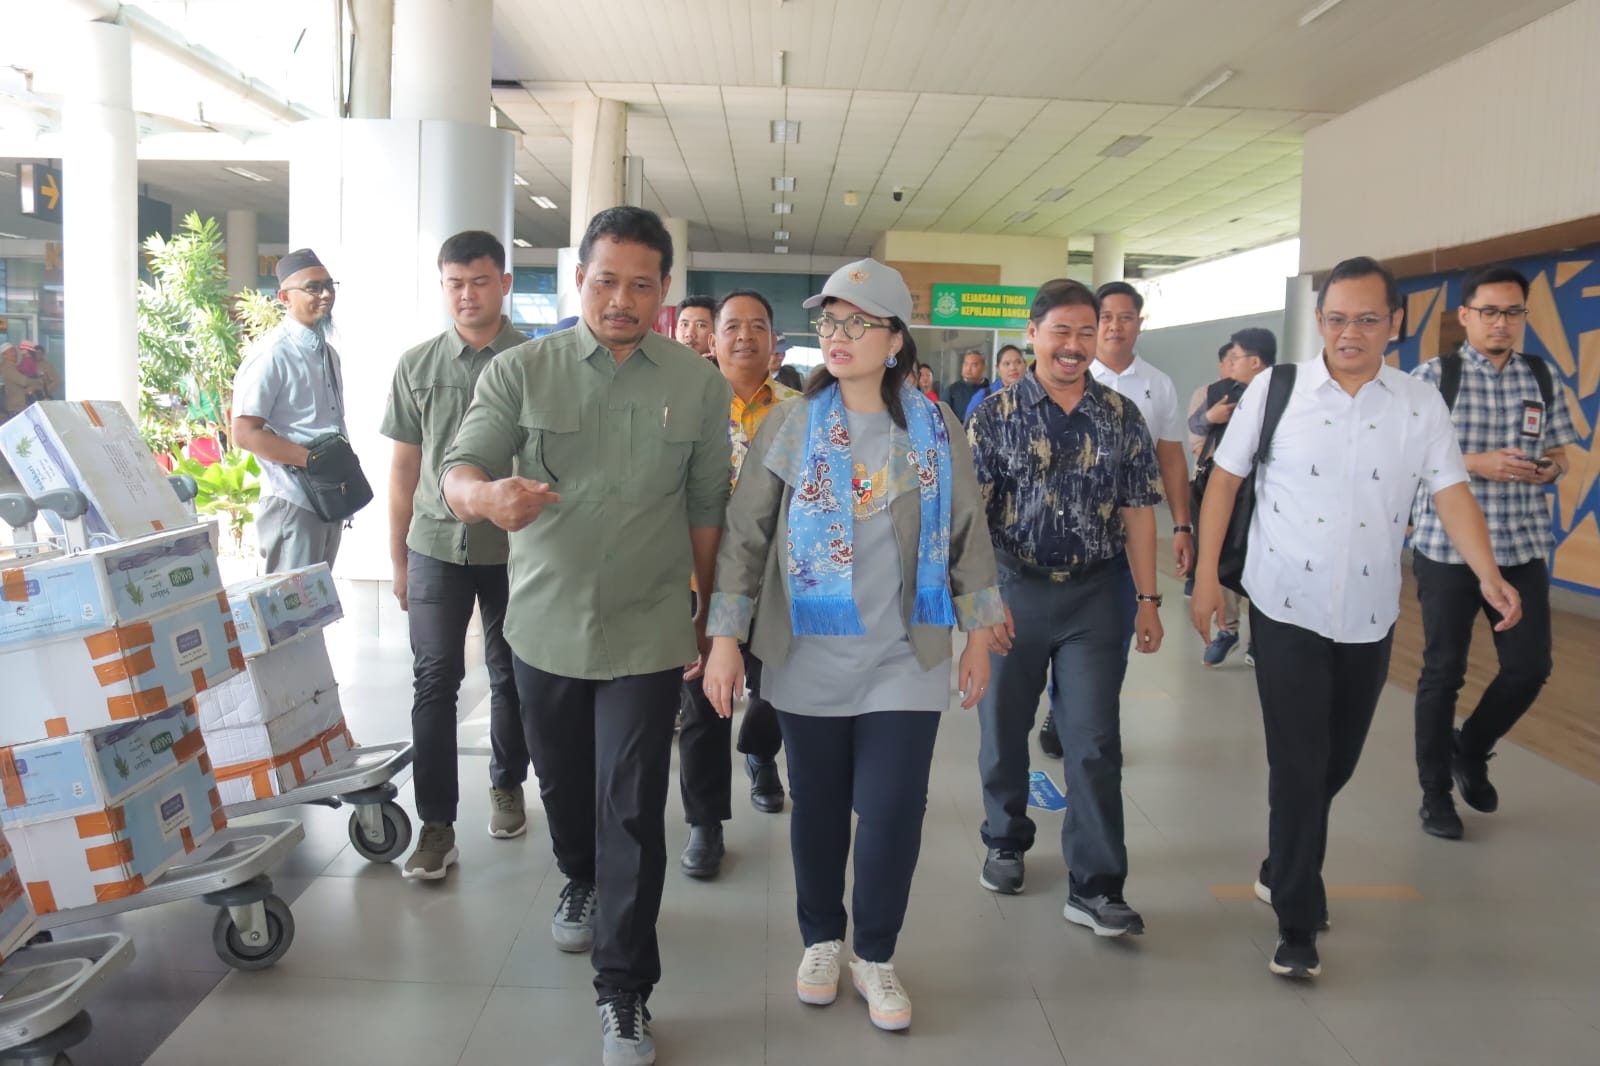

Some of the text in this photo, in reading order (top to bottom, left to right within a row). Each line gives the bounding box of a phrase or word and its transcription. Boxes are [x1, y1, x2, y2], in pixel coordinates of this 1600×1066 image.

[960, 292, 1027, 305] KEJAKSAAN TINGGI
[960, 305, 1001, 317] KEPULAUAN
